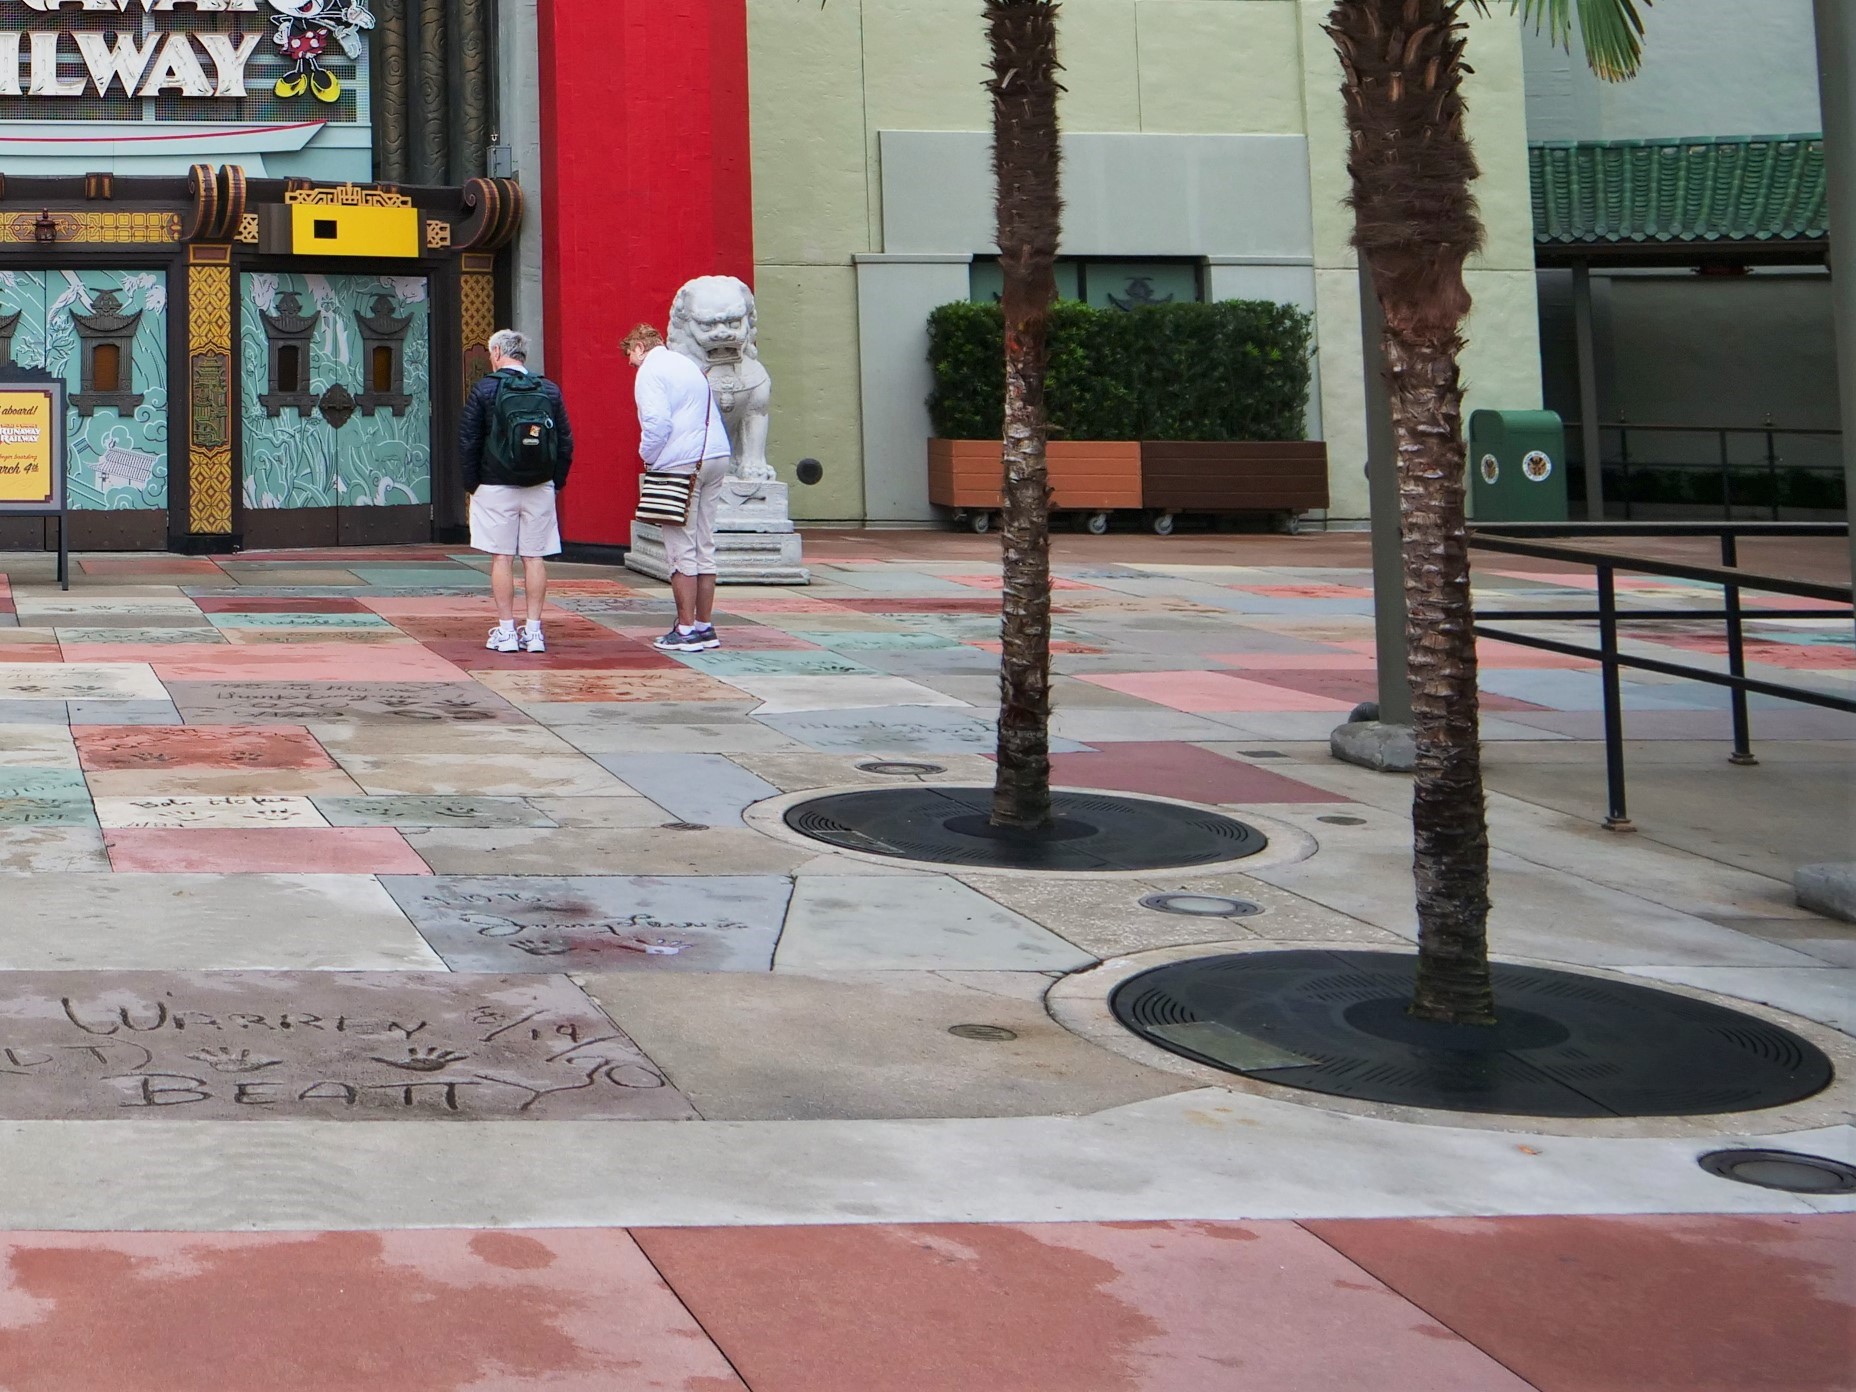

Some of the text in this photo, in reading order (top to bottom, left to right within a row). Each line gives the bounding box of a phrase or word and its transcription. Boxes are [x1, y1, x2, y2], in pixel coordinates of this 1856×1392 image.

[1, 405, 39, 415] aboard!
[23, 463, 39, 475] 4th
[99, 1072, 584, 1111] BEATTY
